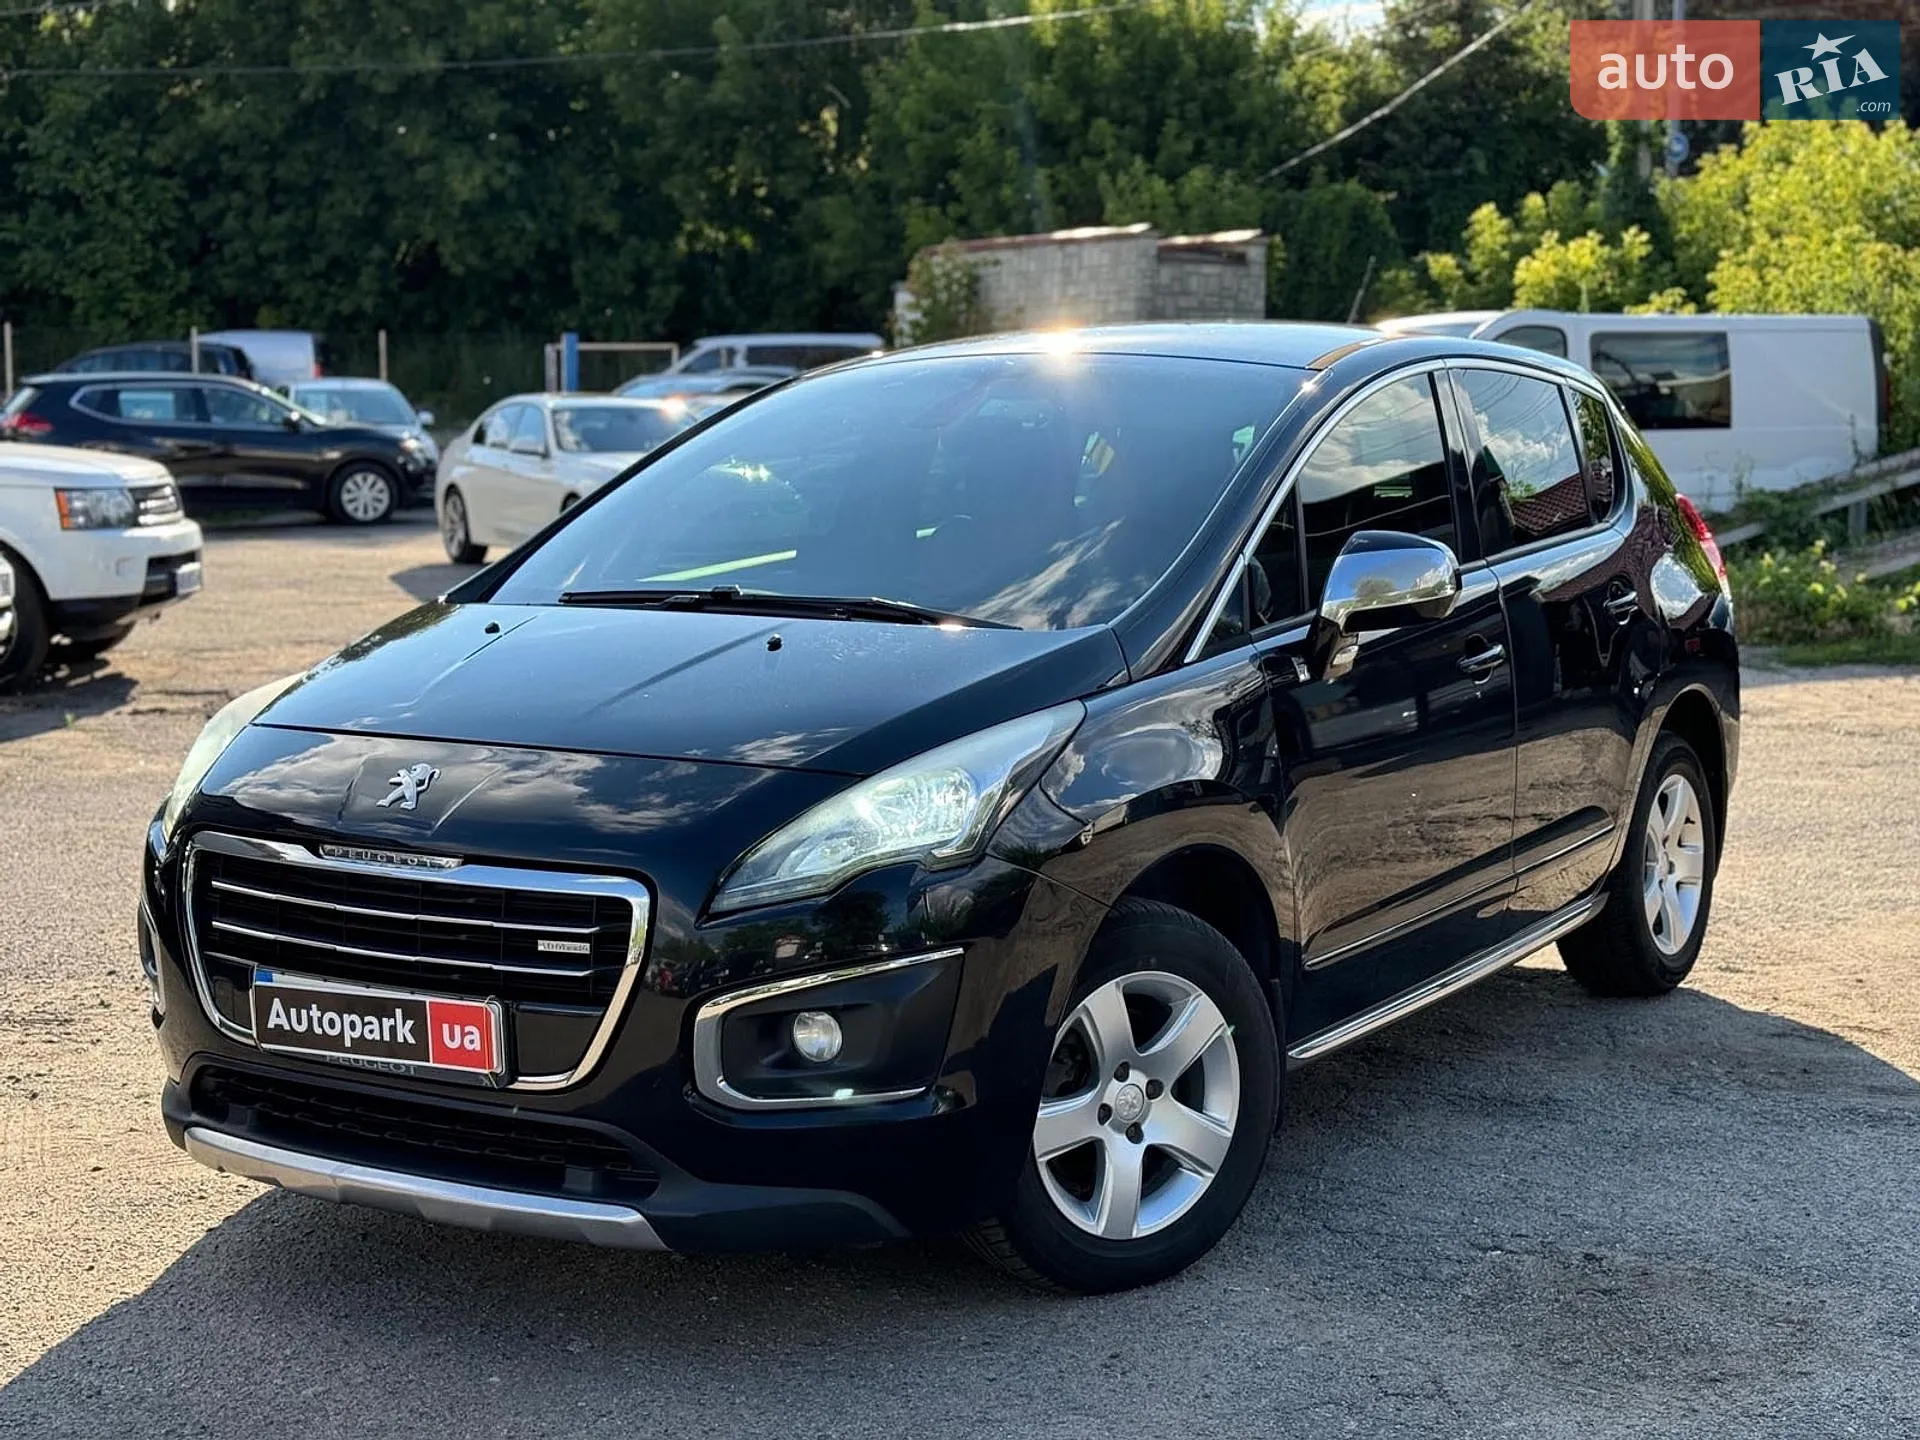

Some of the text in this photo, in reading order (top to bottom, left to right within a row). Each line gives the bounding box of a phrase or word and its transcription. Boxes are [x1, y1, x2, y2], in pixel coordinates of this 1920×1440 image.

[334, 846, 433, 867] PEUGEOT
[267, 998, 482, 1051] Autopark ua
[326, 1054, 418, 1075] PEUGEOT
